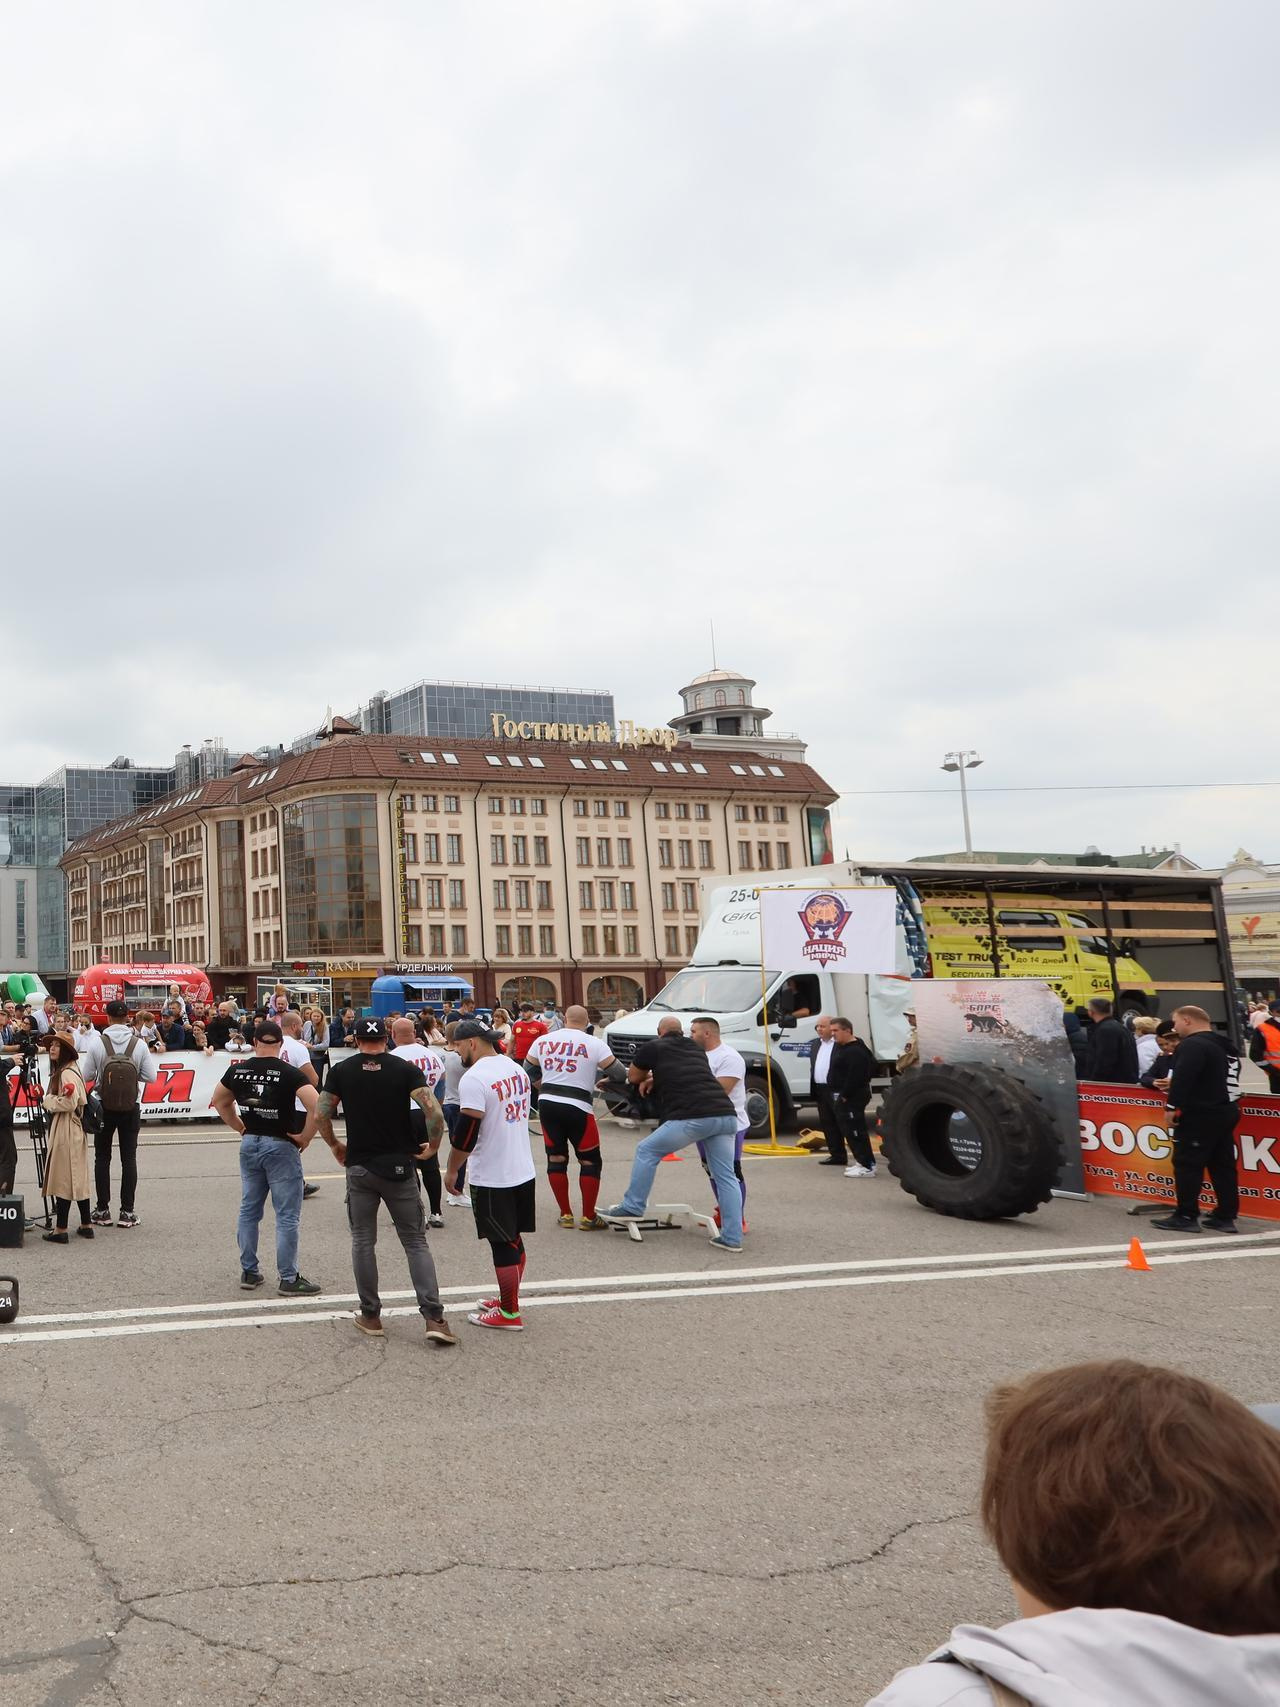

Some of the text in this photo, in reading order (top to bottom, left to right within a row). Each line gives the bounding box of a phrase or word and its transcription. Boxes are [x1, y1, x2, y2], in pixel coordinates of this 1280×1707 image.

[489, 712, 679, 752] Гостиный Двор
[803, 943, 846, 957] НАЦИЯ
[811, 951, 838, 961] МИРА
[935, 952, 1004, 963] TEST TRUK
[394, 963, 454, 973] ТРДЕЛЬНИК
[951, 971, 1007, 979] БЕСПЛАТНЯ
[538, 1040, 589, 1059] ТУЛА
[544, 1057, 577, 1073] 875
[233, 1074, 280, 1082] FREEDOM
[491, 1072, 531, 1102] ТУЛА
[141, 1107, 191, 1115] .tulasila.ru
[505, 1099, 528, 1123] 875
[1078, 1095, 1280, 1119] ко-юношеская школ
[1124, 1170, 1143, 1182] ул.
[0, 1297, 12, 1308] 24
